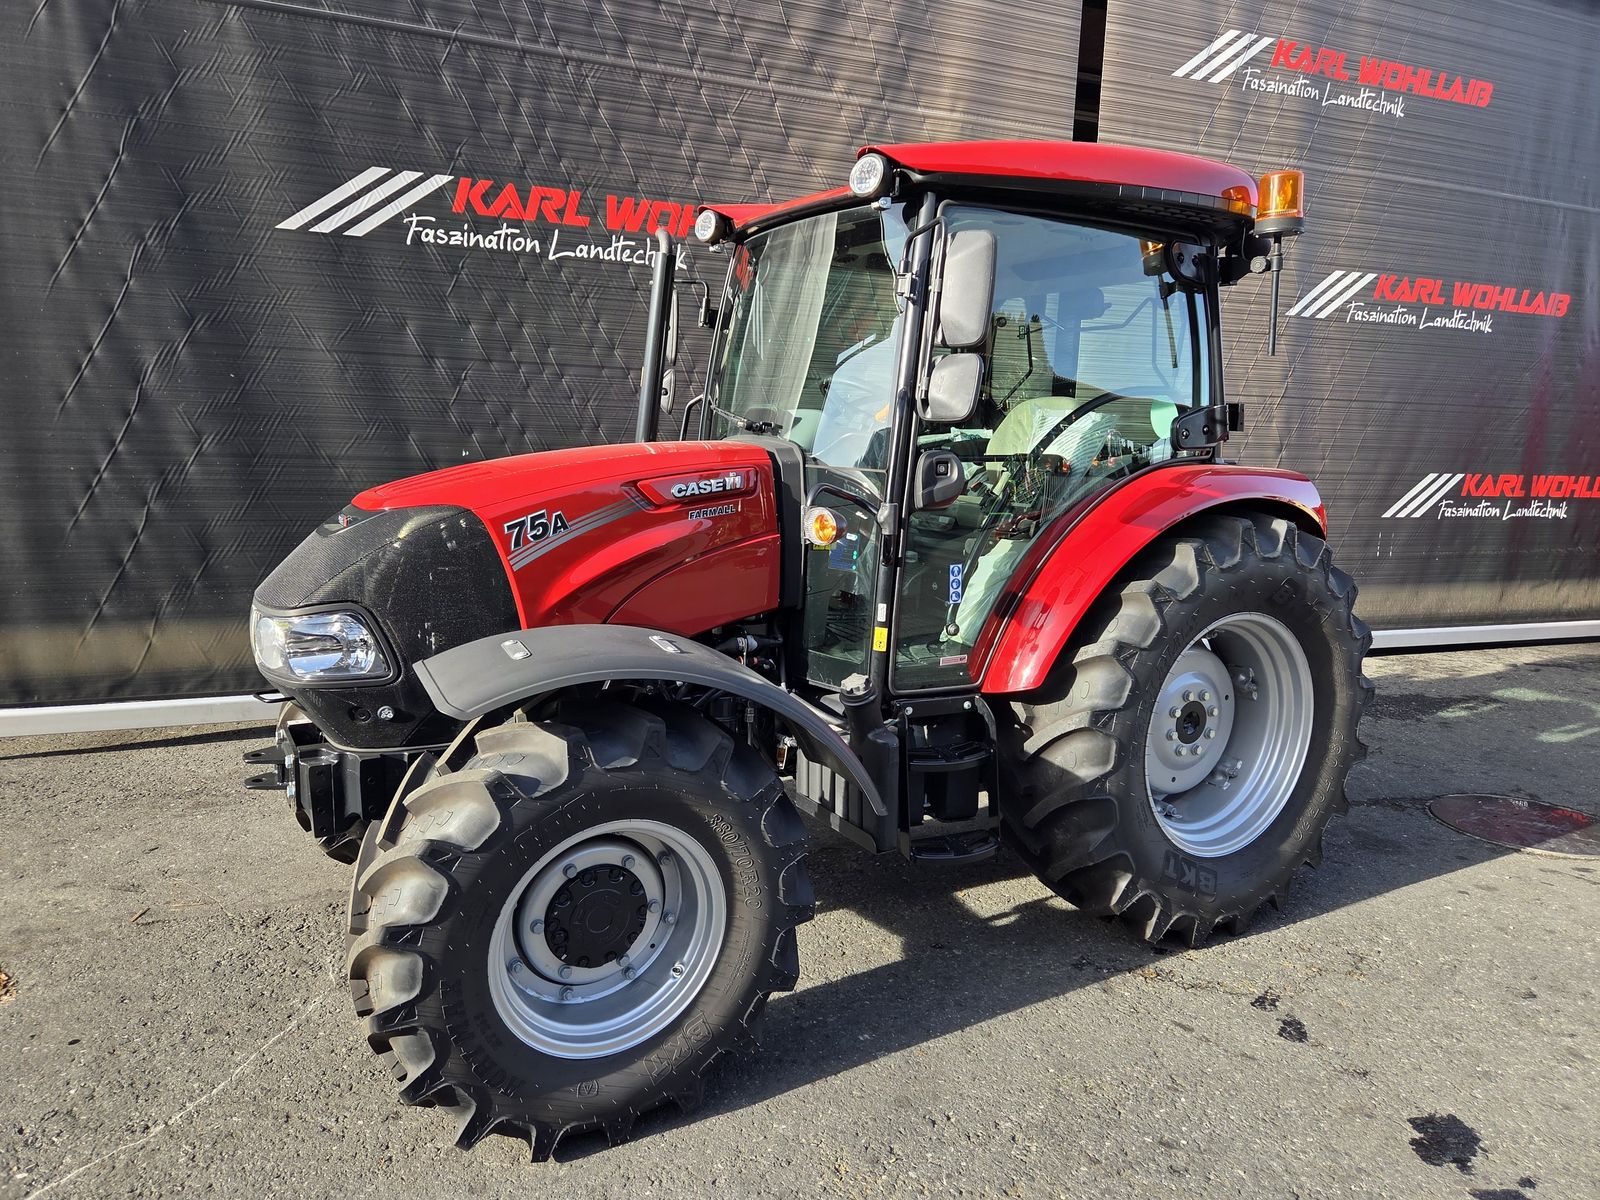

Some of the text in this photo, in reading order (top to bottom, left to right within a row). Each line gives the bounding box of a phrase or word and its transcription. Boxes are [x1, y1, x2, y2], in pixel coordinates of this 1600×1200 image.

[1271, 39, 1350, 80] KARL
[1242, 66, 1405, 117] Faszination Landtechnik
[452, 177, 590, 227] KARL
[403, 212, 541, 255] Faszination
[548, 228, 687, 271] Landtechk
[1374, 274, 1445, 305] KARL
[1346, 300, 1492, 333] Faszination Landtechnik
[1461, 474, 1525, 497] KARL
[504, 509, 570, 550] 75A
[688, 504, 736, 521] FARMALL
[1438, 500, 1567, 521] Faszination Landtechnik
[710, 813, 763, 910] 380/70R20
[1163, 856, 1217, 897] BKT
[645, 1014, 711, 1081] BKT
